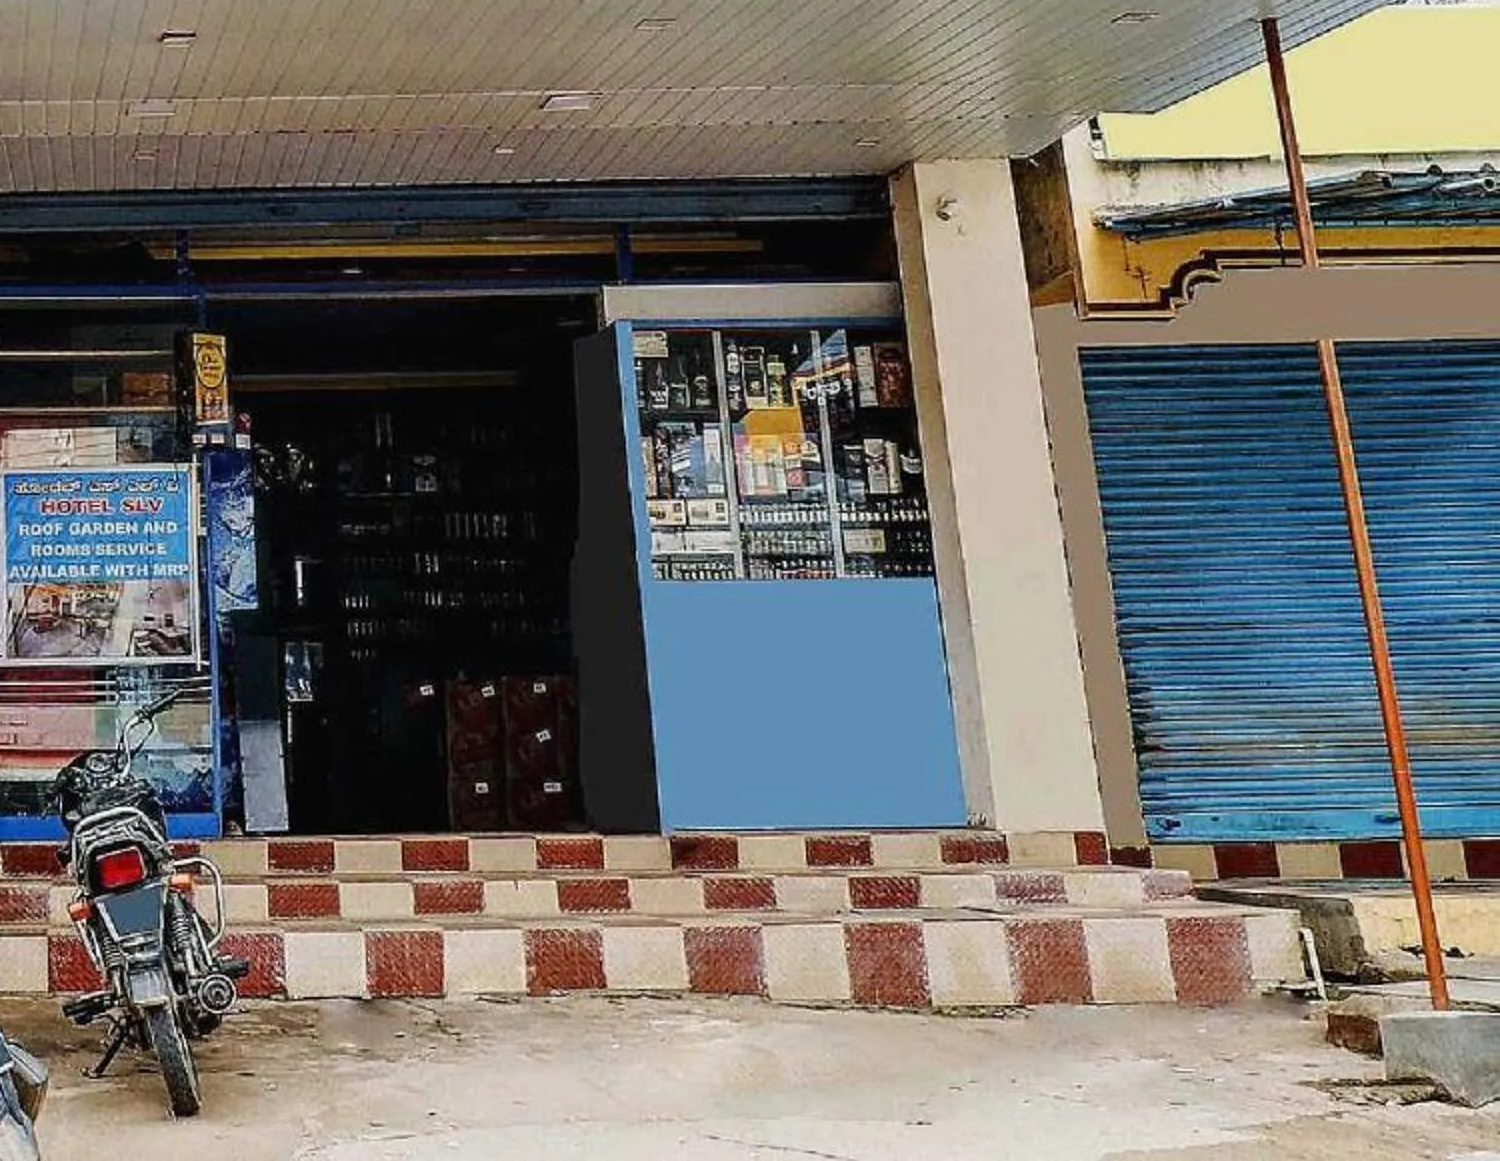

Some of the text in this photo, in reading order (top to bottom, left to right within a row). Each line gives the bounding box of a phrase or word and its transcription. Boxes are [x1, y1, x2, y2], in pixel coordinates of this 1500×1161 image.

[39, 497, 164, 515] HOTEL SLV
[19, 520, 178, 536] ROOF GARDEN AND
[31, 542, 167, 557] ROOMS SERVICE
[9, 563, 190, 579] AVAILABLE WITH MRP
